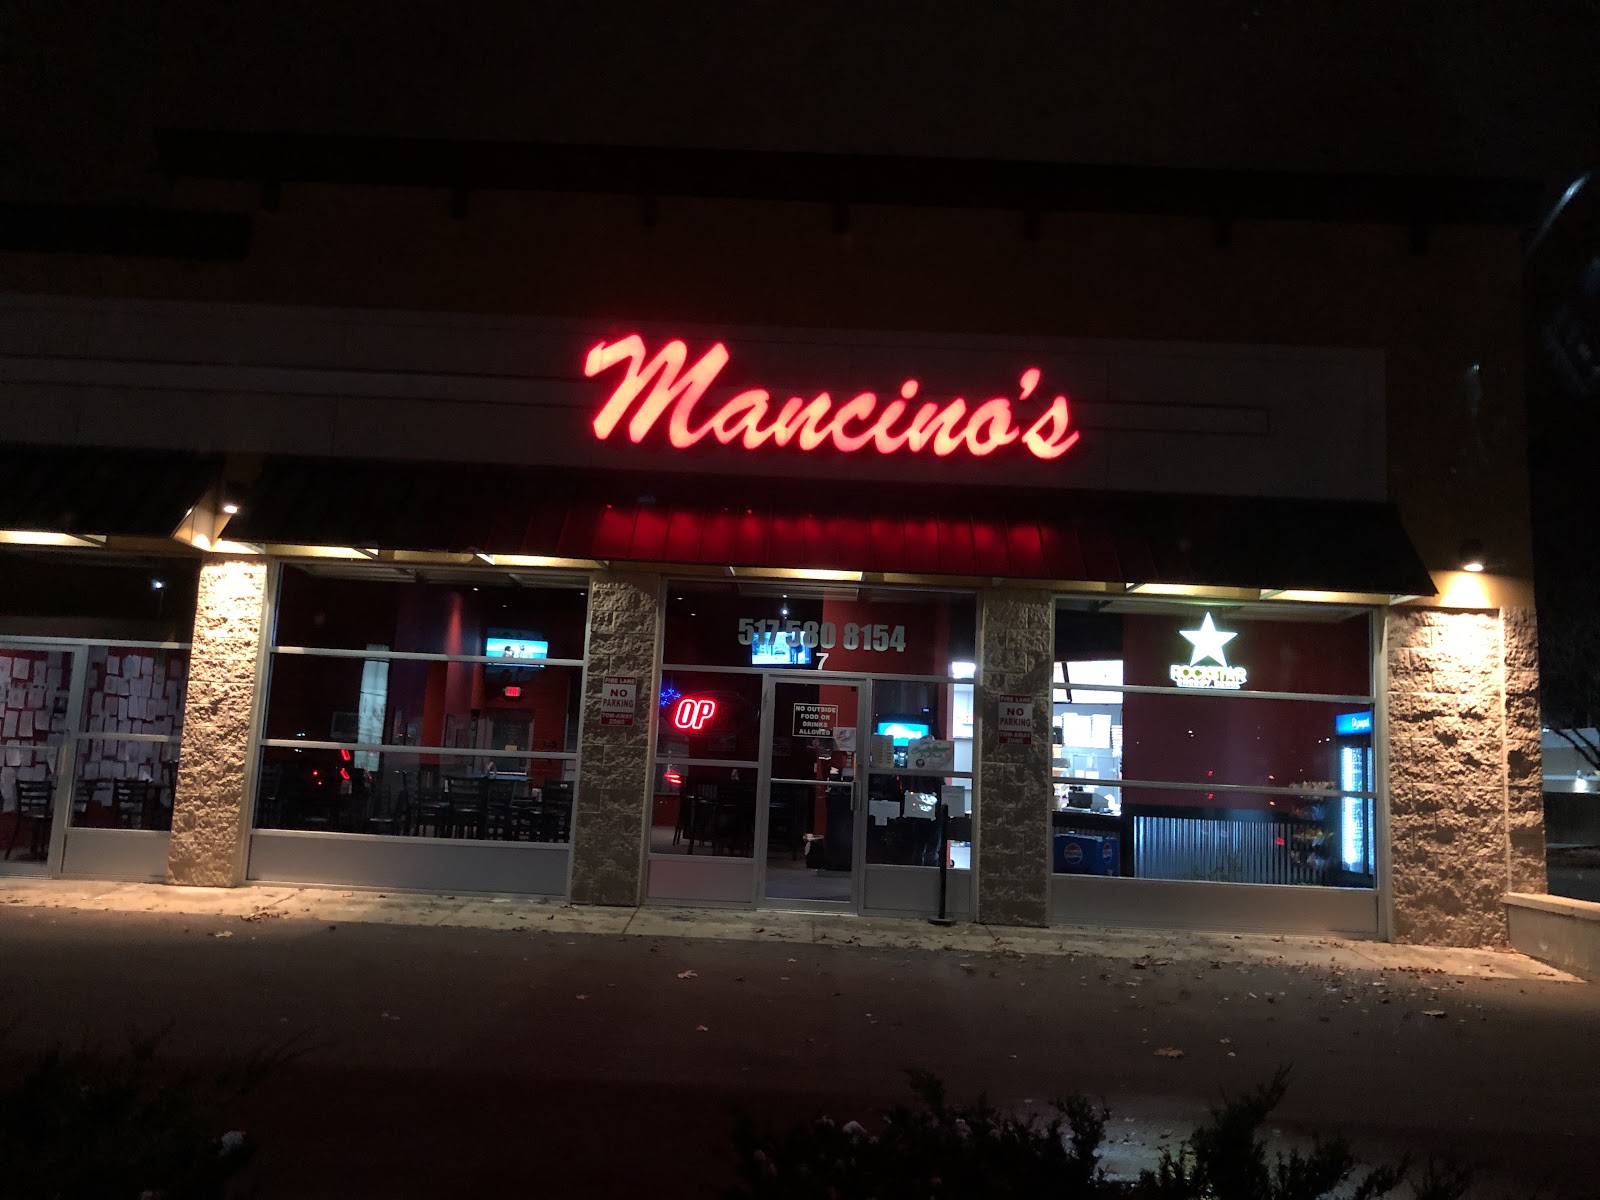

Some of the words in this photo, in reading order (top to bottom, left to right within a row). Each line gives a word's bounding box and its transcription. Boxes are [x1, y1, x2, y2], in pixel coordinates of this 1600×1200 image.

[584, 334, 1080, 460] Mancino's
[737, 618, 780, 646] 517
[785, 620, 837, 649] 580
[843, 622, 907, 653] 8154
[815, 652, 830, 670] 7
[610, 689, 627, 697] NO
[602, 699, 634, 708] PARKING
[1007, 708, 1024, 716] NO
[999, 718, 1031, 727] PARKING
[798, 728, 831, 736] ALLOWED
